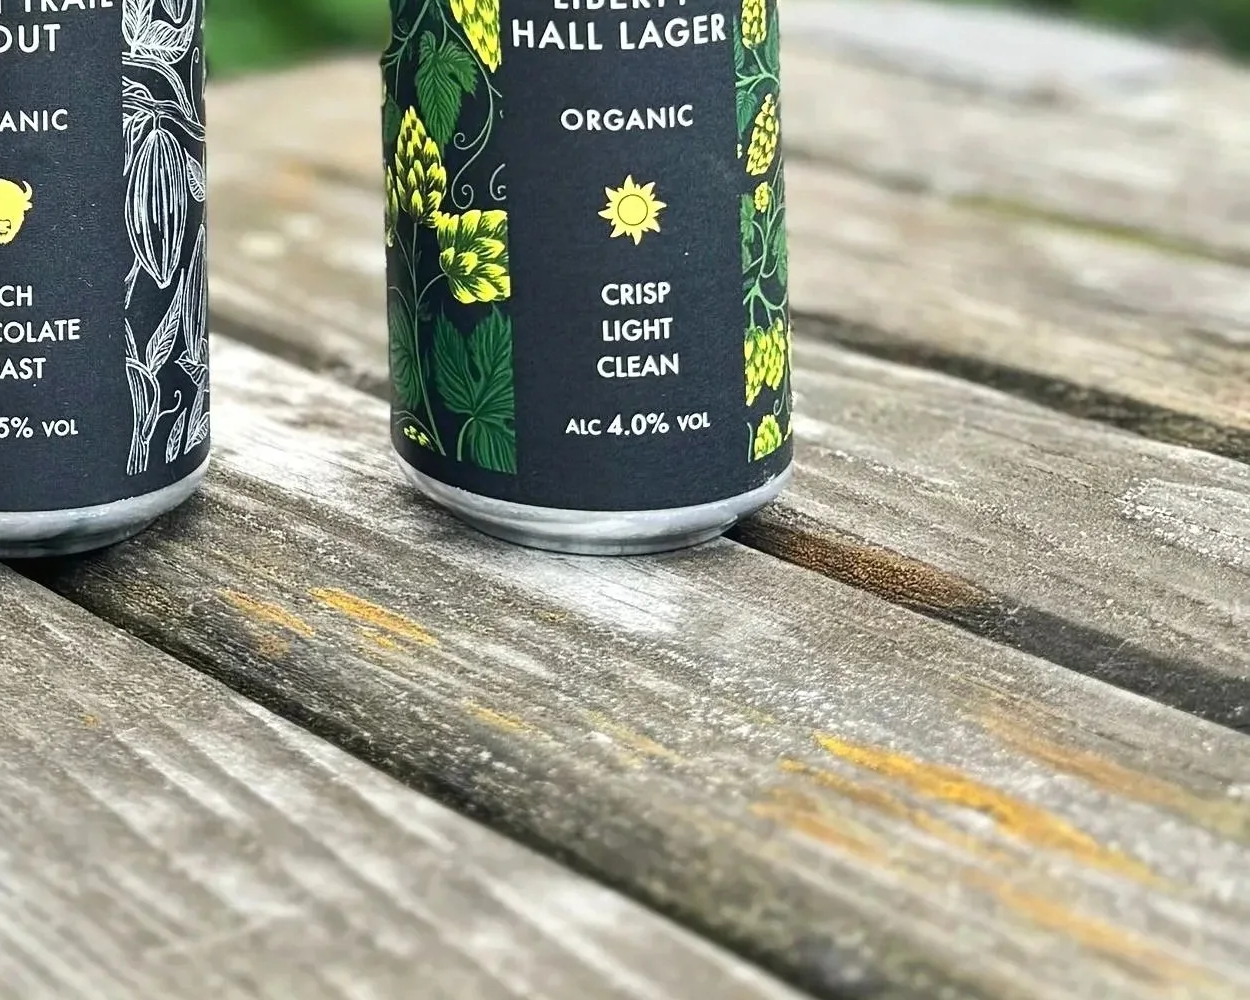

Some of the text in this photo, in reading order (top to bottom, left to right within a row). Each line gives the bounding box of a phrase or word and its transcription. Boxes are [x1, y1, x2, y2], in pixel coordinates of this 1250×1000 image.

[512, 12, 727, 51] HALL LAGER
[560, 103, 694, 132] ORGANIC
[601, 281, 671, 306] CRISP
[602, 316, 674, 342] LIGHT
[596, 352, 680, 379] CLEAN
[41, 418, 79, 438] VOL
[565, 411, 711, 436] ALC 4.0% VOL
